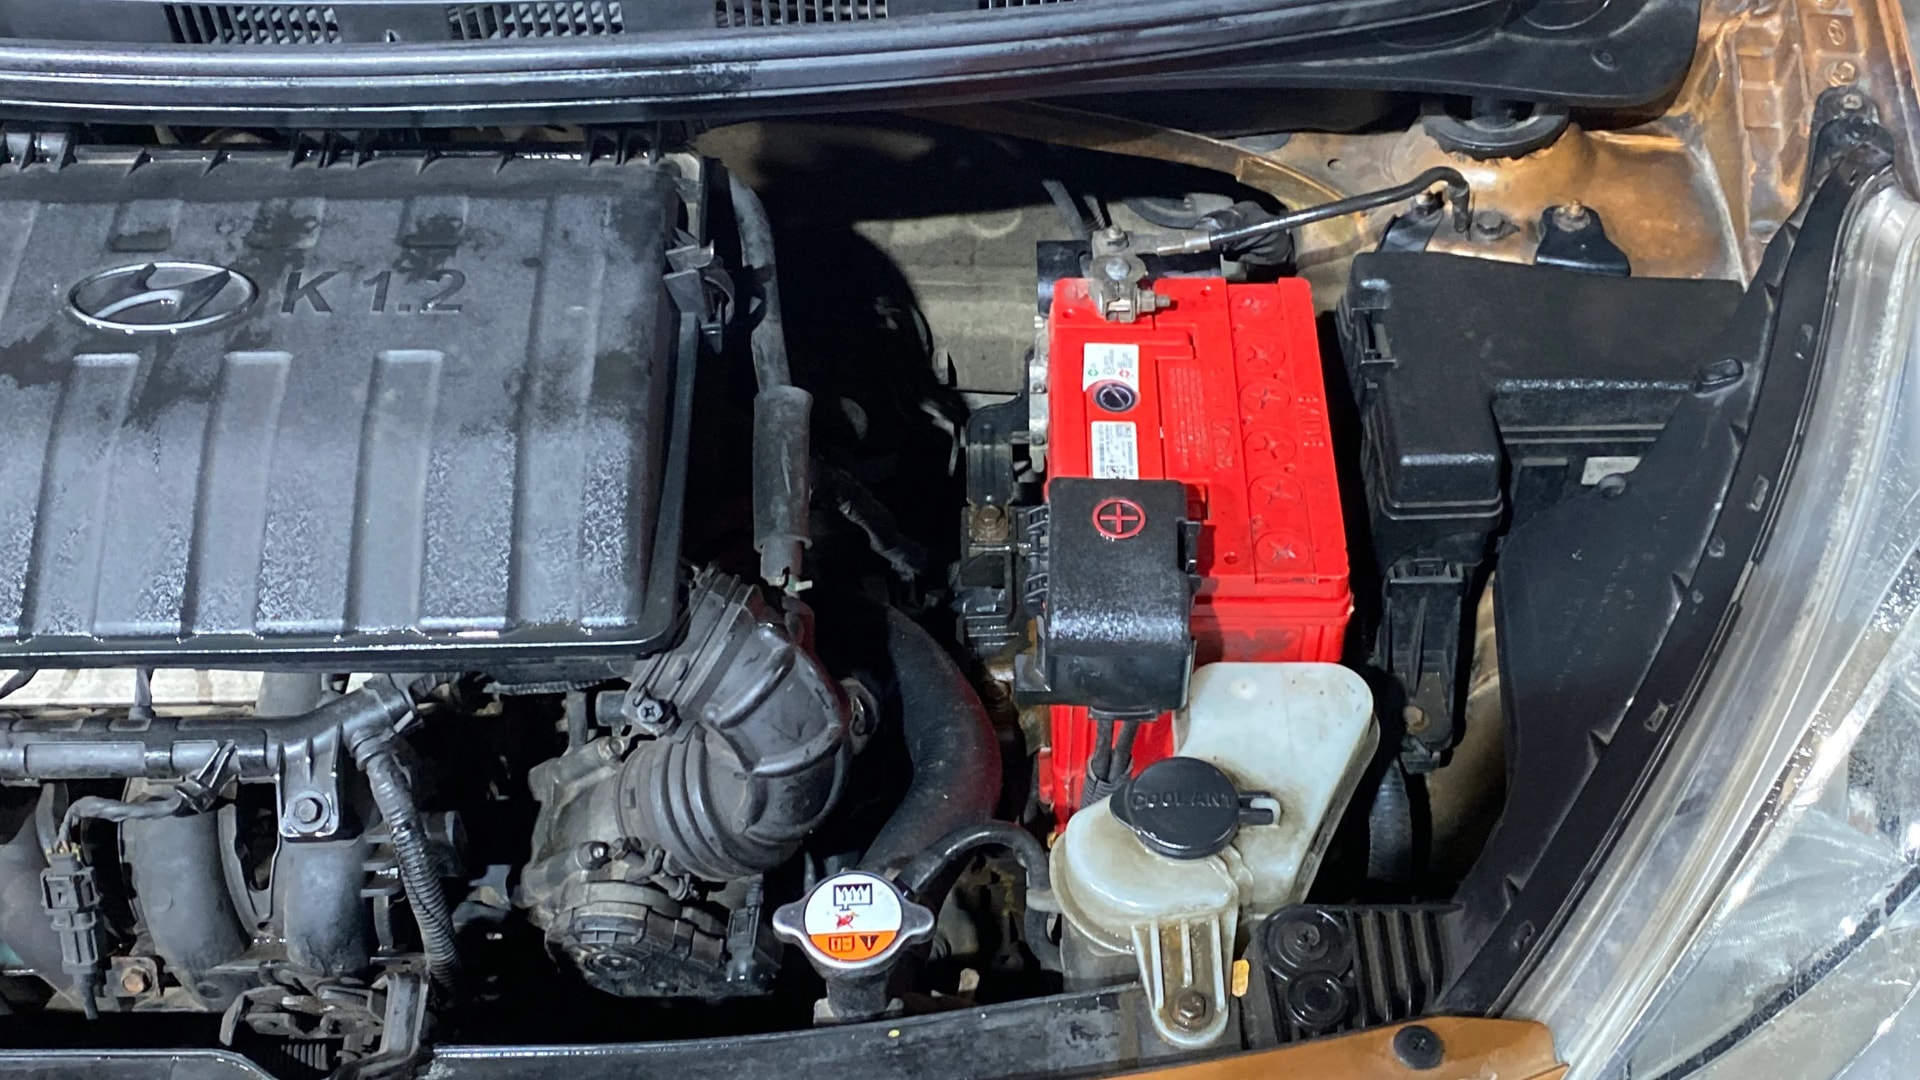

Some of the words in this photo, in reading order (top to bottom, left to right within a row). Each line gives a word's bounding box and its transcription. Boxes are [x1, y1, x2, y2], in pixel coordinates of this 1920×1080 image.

[281, 270, 337, 314] K
[361, 268, 466, 314] 1.2
[1131, 792, 1233, 810] COOLANT
